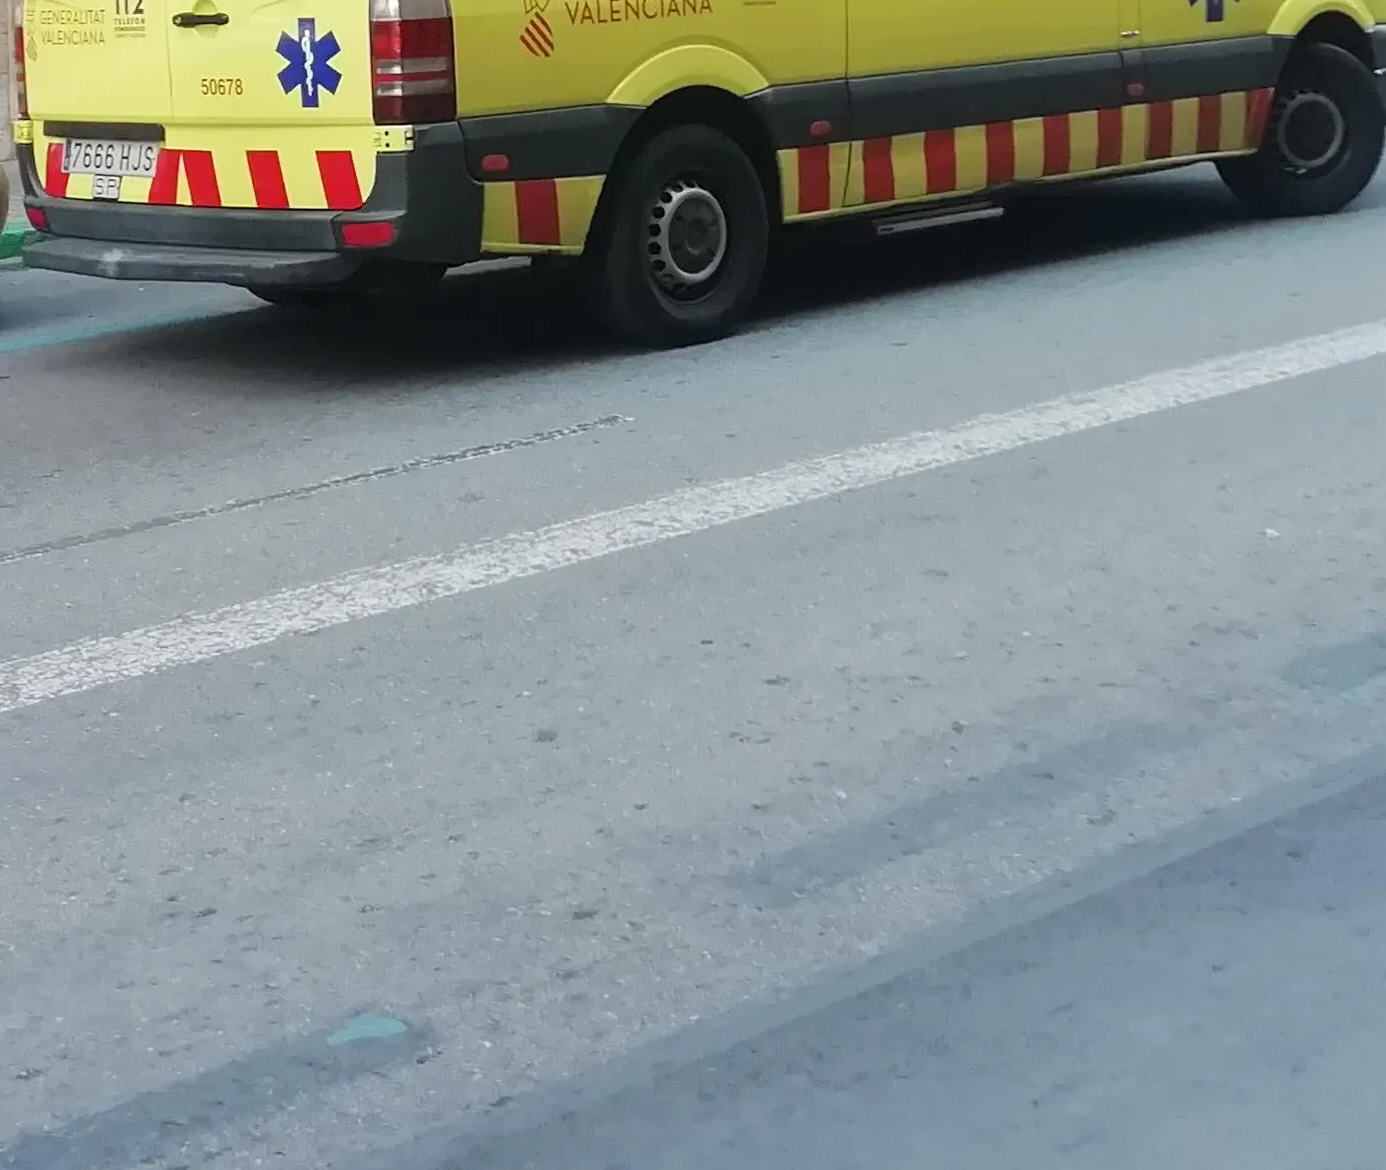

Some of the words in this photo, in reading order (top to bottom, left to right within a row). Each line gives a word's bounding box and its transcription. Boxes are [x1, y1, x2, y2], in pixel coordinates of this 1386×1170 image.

[40, 10, 106, 25] GENERALITAT
[40, 30, 106, 46] VALENCIANA
[200, 78, 244, 96] 50678
[73, 142, 115, 169] 7666
[119, 144, 154, 172] HJS
[95, 178, 117, 195] SP
